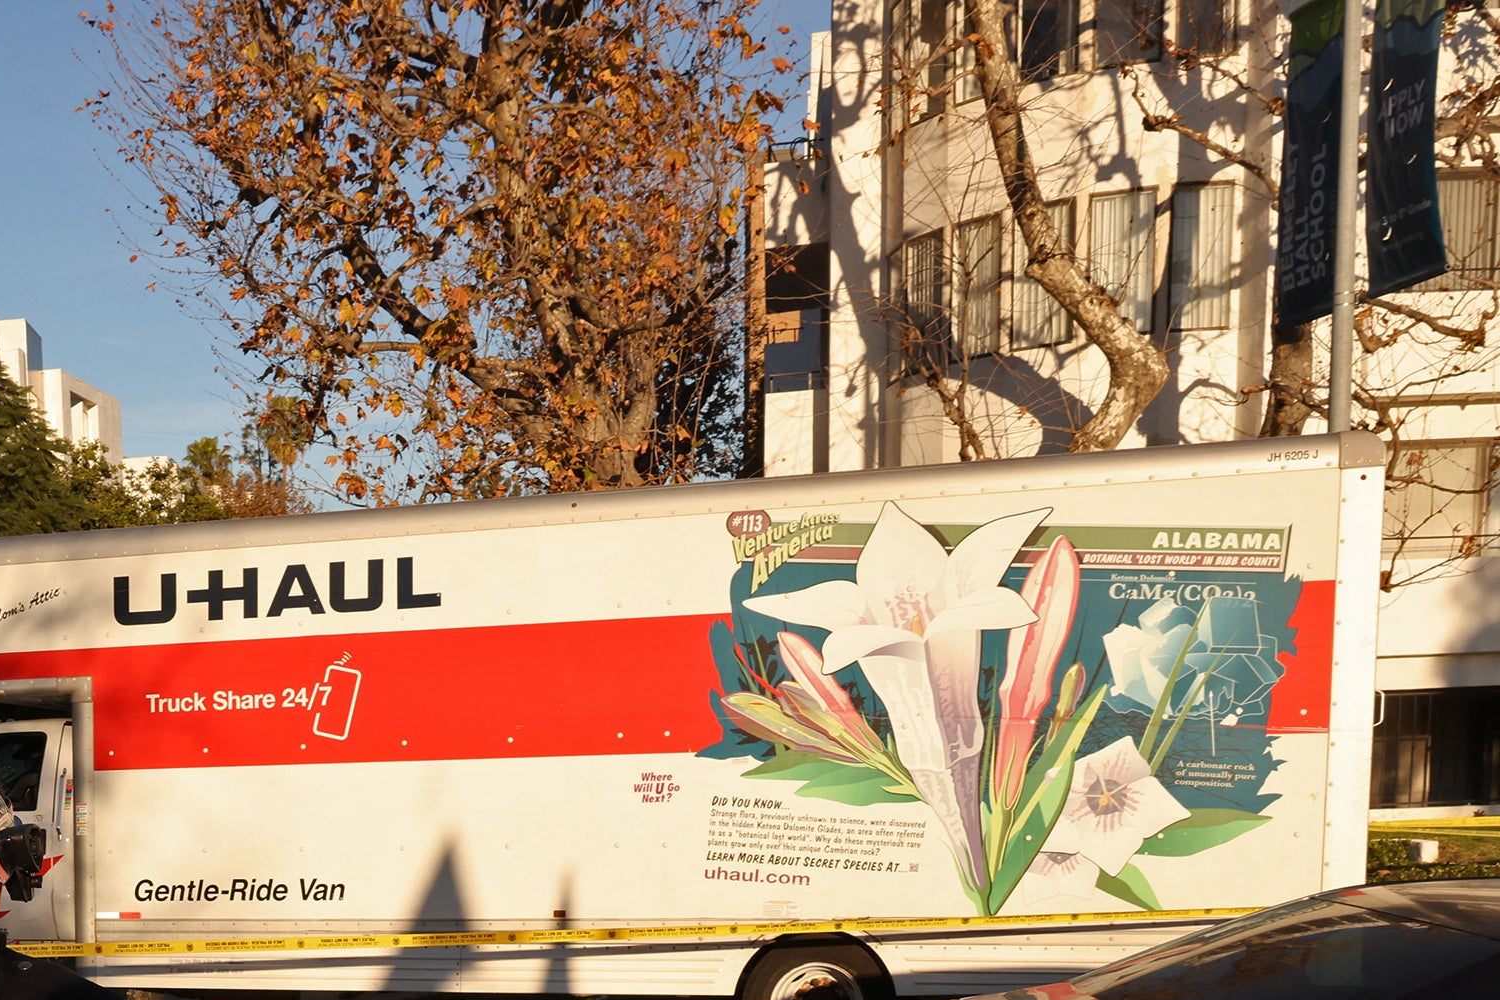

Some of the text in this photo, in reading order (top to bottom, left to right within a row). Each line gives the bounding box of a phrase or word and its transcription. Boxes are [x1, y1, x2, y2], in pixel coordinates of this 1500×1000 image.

[1378, 78, 1426, 122] APPLY
[1384, 102, 1425, 141] NOW
[1308, 143, 1328, 281] SCHOOL
[1294, 205, 1311, 287] HALL
[1267, 449, 1319, 463] JH 6205 J
[732, 514, 763, 533] #113
[732, 520, 798, 564] Venture
[1152, 531, 1282, 550] ALABAMA
[750, 524, 834, 597] America
[1083, 553, 1132, 564] BOTANICAL
[1202, 555, 1212, 565] IN
[1215, 556, 1239, 566] BIBB
[1241, 556, 1280, 567] COUNTY
[28, 587, 62, 608] Attic
[145, 682, 332, 713] Truck Share 24/7
[1186, 761, 1232, 770] carbonate
[1234, 763, 1255, 771] rock
[1188, 770, 1233, 780] unusually
[1234, 773, 1257, 781] pure
[641, 772, 673, 782] Where
[1174, 779, 1235, 788] composition.
[633, 782, 680, 795] Will U Go
[641, 793, 673, 804] Next?
[710, 809, 737, 819] Strange
[760, 813, 795, 823] previously
[797, 815, 827, 824] unknown
[889, 819, 927, 828] discovered
[732, 820, 754, 828] hidden
[756, 822, 780, 830] Ketona
[783, 823, 815, 832] Dolomite
[875, 828, 894, 837] often
[896, 830, 925, 839] referred
[708, 840, 728, 848] plants
[730, 841, 747, 849] grow
[749, 842, 764, 850] only
[783, 843, 796, 851] this
[799, 845, 821, 854] unique
[823, 845, 858, 855] Cambrian
[860, 847, 881, 856] rock?
[772, 832, 785, 841] lost
[815, 836, 831, 845] Why
[845, 837, 864, 845] these
[866, 839, 904, 848] mysterious
[706, 850, 736, 862] LEARN
[737, 852, 765, 864] MORE
[767, 854, 801, 866] ABOUT
[803, 856, 841, 869] SECRET
[842, 859, 883, 871] SPECIES
[704, 866, 811, 887] uhaul.com
[134, 878, 346, 902] Gentle-Ride Van
